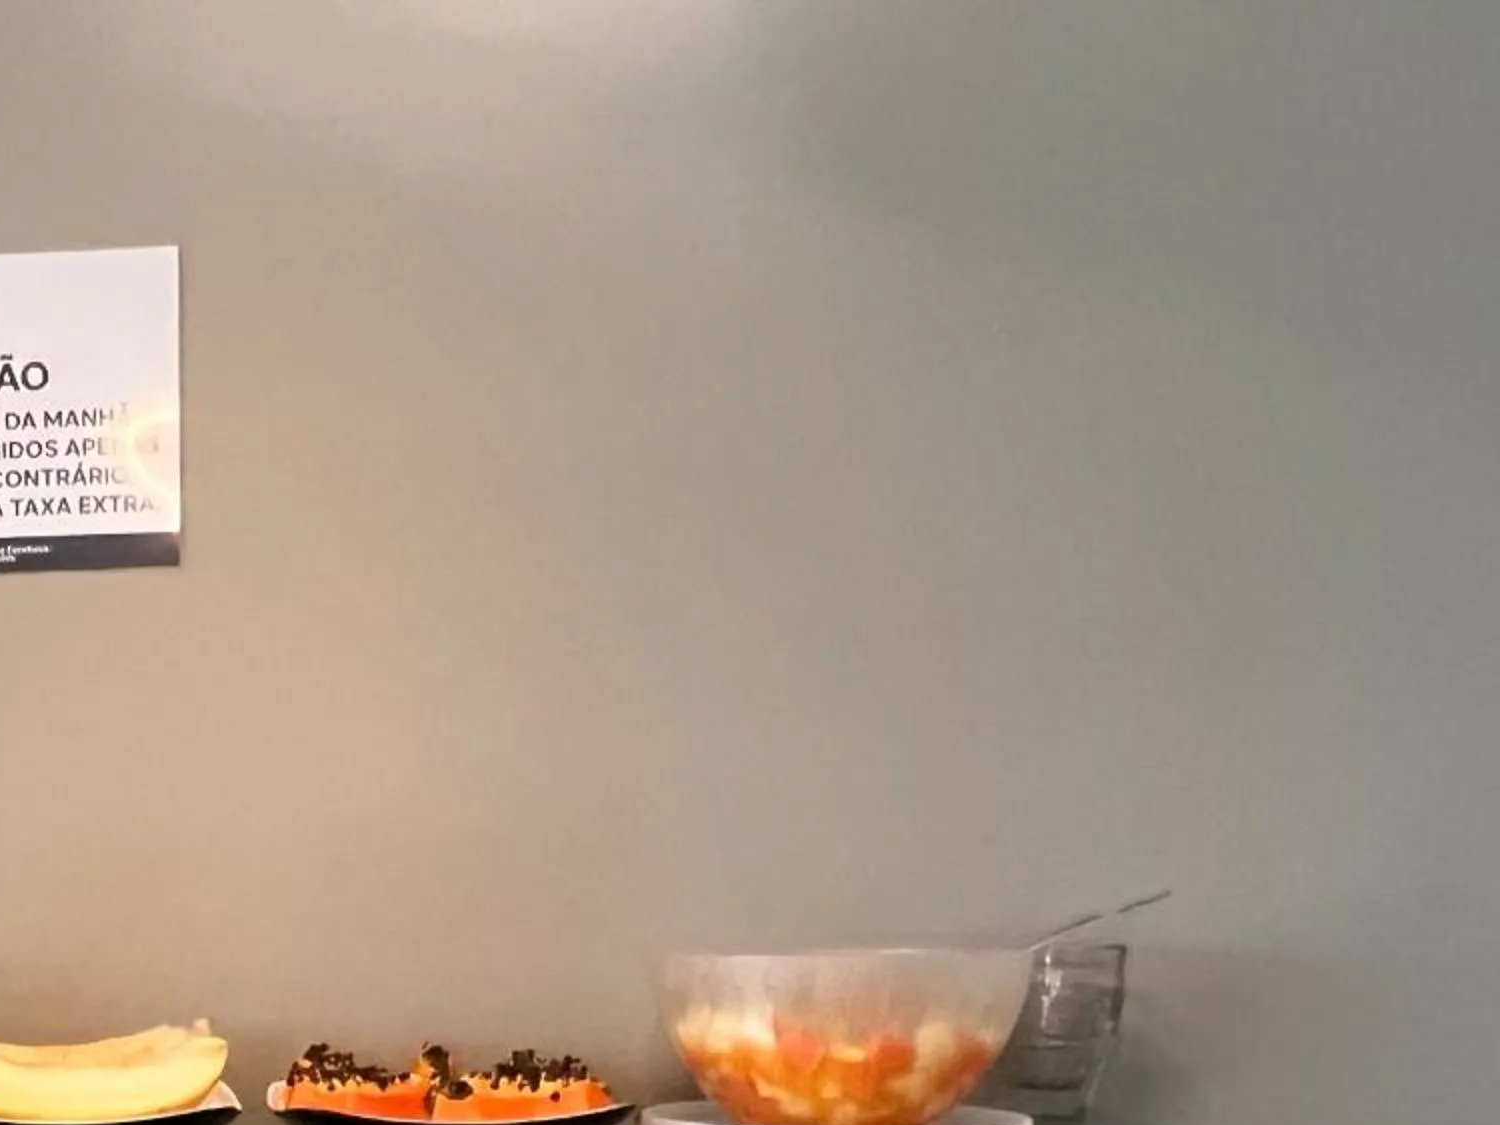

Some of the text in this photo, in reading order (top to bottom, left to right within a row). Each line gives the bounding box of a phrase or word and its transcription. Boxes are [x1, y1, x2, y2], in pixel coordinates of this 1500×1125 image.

[5, 411, 37, 430] DA
[65, 437, 159, 457] APE
[9, 497, 72, 517] TAXA
